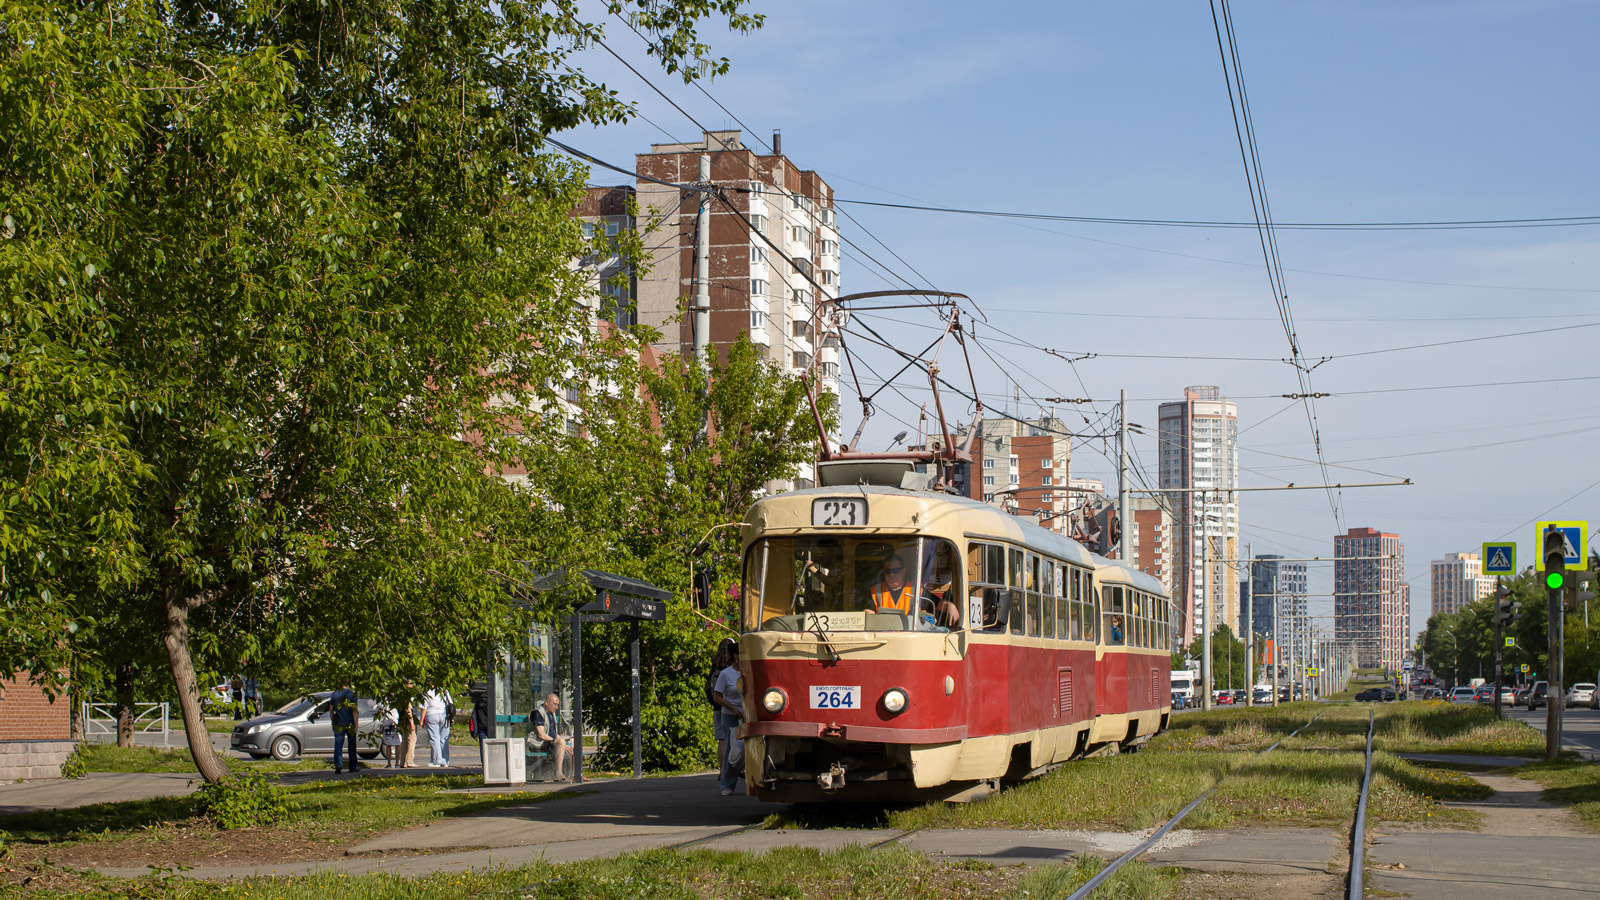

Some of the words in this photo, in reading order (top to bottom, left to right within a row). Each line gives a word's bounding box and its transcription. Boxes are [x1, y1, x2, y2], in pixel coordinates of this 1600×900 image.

[824, 502, 856, 526] 23
[808, 615, 830, 631] 23
[971, 603, 982, 624] 23
[817, 691, 853, 708] 264
